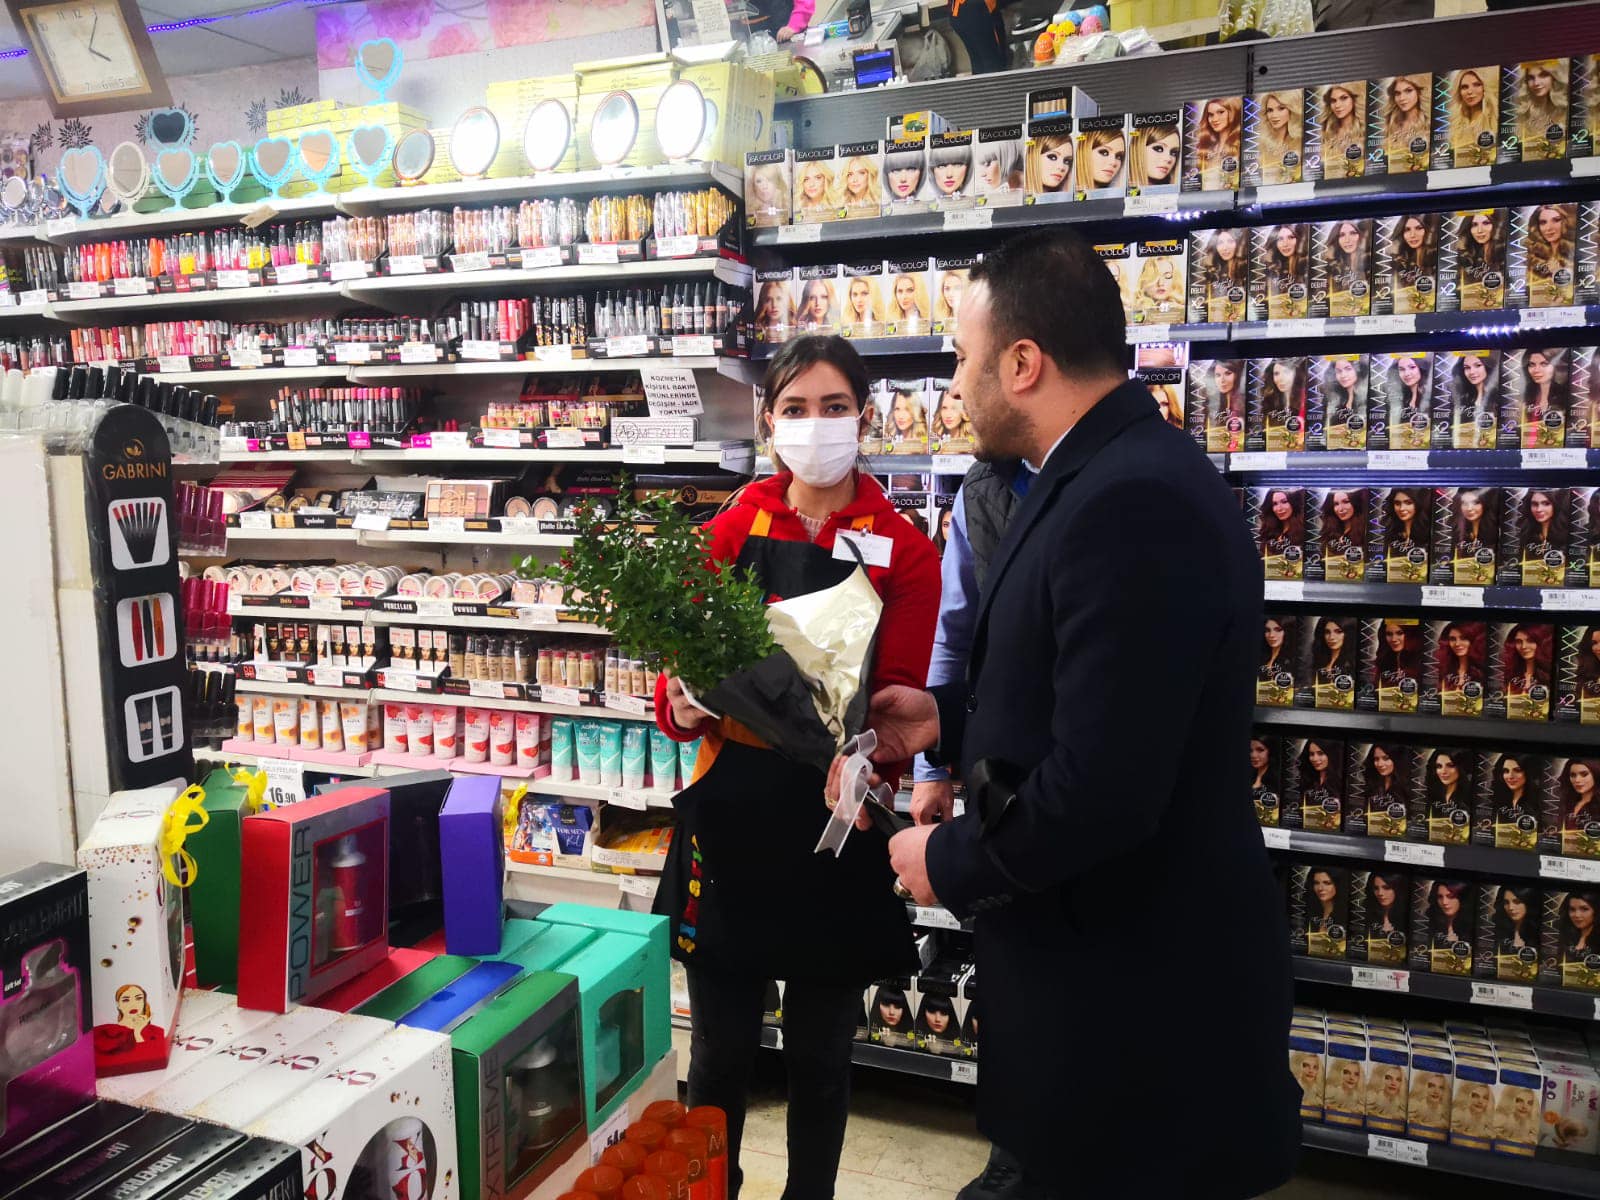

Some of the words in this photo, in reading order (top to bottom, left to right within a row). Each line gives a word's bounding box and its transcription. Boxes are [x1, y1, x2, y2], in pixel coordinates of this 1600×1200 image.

[1244, 97, 1261, 154] MAXX
[1305, 89, 1323, 146] MAXX
[1368, 82, 1385, 139] MAXX
[1434, 77, 1452, 132] MAXX
[1191, 231, 1207, 288] MAXX
[1250, 227, 1267, 284] MAXX
[1311, 224, 1328, 282] MAXX
[1375, 218, 1392, 277] MAXX
[1440, 214, 1458, 275] MAXX
[1508, 209, 1528, 269] MAXX
[1578, 203, 1598, 265] MAXX
[1190, 363, 1207, 416] MAXX
[1248, 362, 1265, 415] MAXX
[1308, 357, 1327, 413] MAXX
[1370, 356, 1389, 412] MAXX
[1434, 355, 1453, 411] MAXX
[1502, 351, 1521, 411] MAXX
[1571, 351, 1591, 409] MAXX
[102, 461, 168, 486] GABRINI
[1305, 490, 1323, 544] MAXX
[1369, 491, 1386, 544] MAXX
[1435, 489, 1454, 547] MAXX
[1504, 490, 1523, 549] MAXX
[1570, 490, 1589, 548] MAXX
[1360, 619, 1378, 674] MAXX
[1423, 622, 1440, 680] MAXX
[1560, 627, 1579, 685] MAXX
[1349, 745, 1366, 799] MAXX
[1543, 760, 1561, 817] MAXX
[289, 825, 311, 1004] POWER
